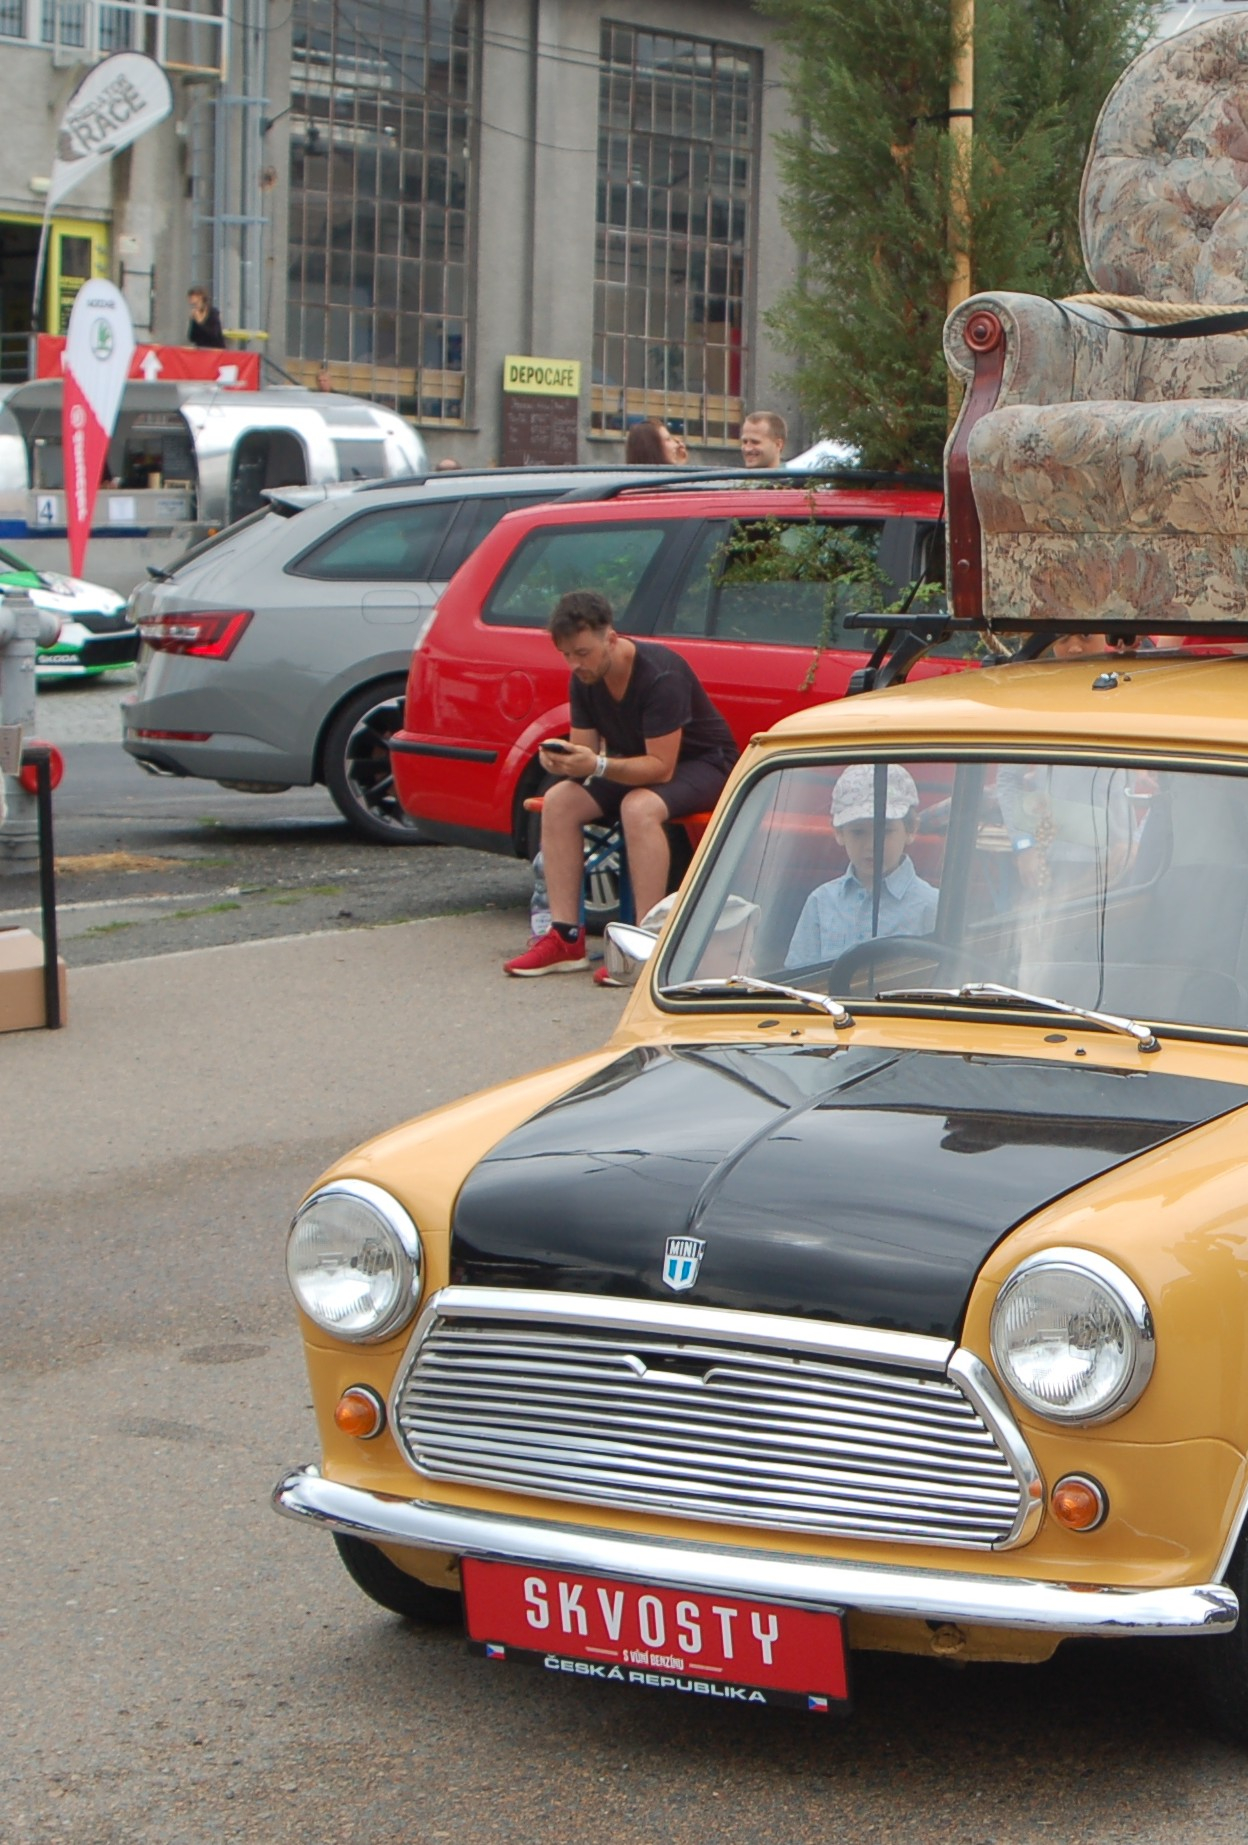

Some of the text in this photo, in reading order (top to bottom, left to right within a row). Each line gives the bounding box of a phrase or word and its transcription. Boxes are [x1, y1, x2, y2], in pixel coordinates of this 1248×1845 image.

[67, 82, 147, 151] RACE
[40, 500, 53, 522] 4
[669, 1240, 697, 1258] MINI
[523, 1576, 779, 1665] SKVOSTY
[544, 1654, 767, 1703] ČESKÁ REPUBLIKA
